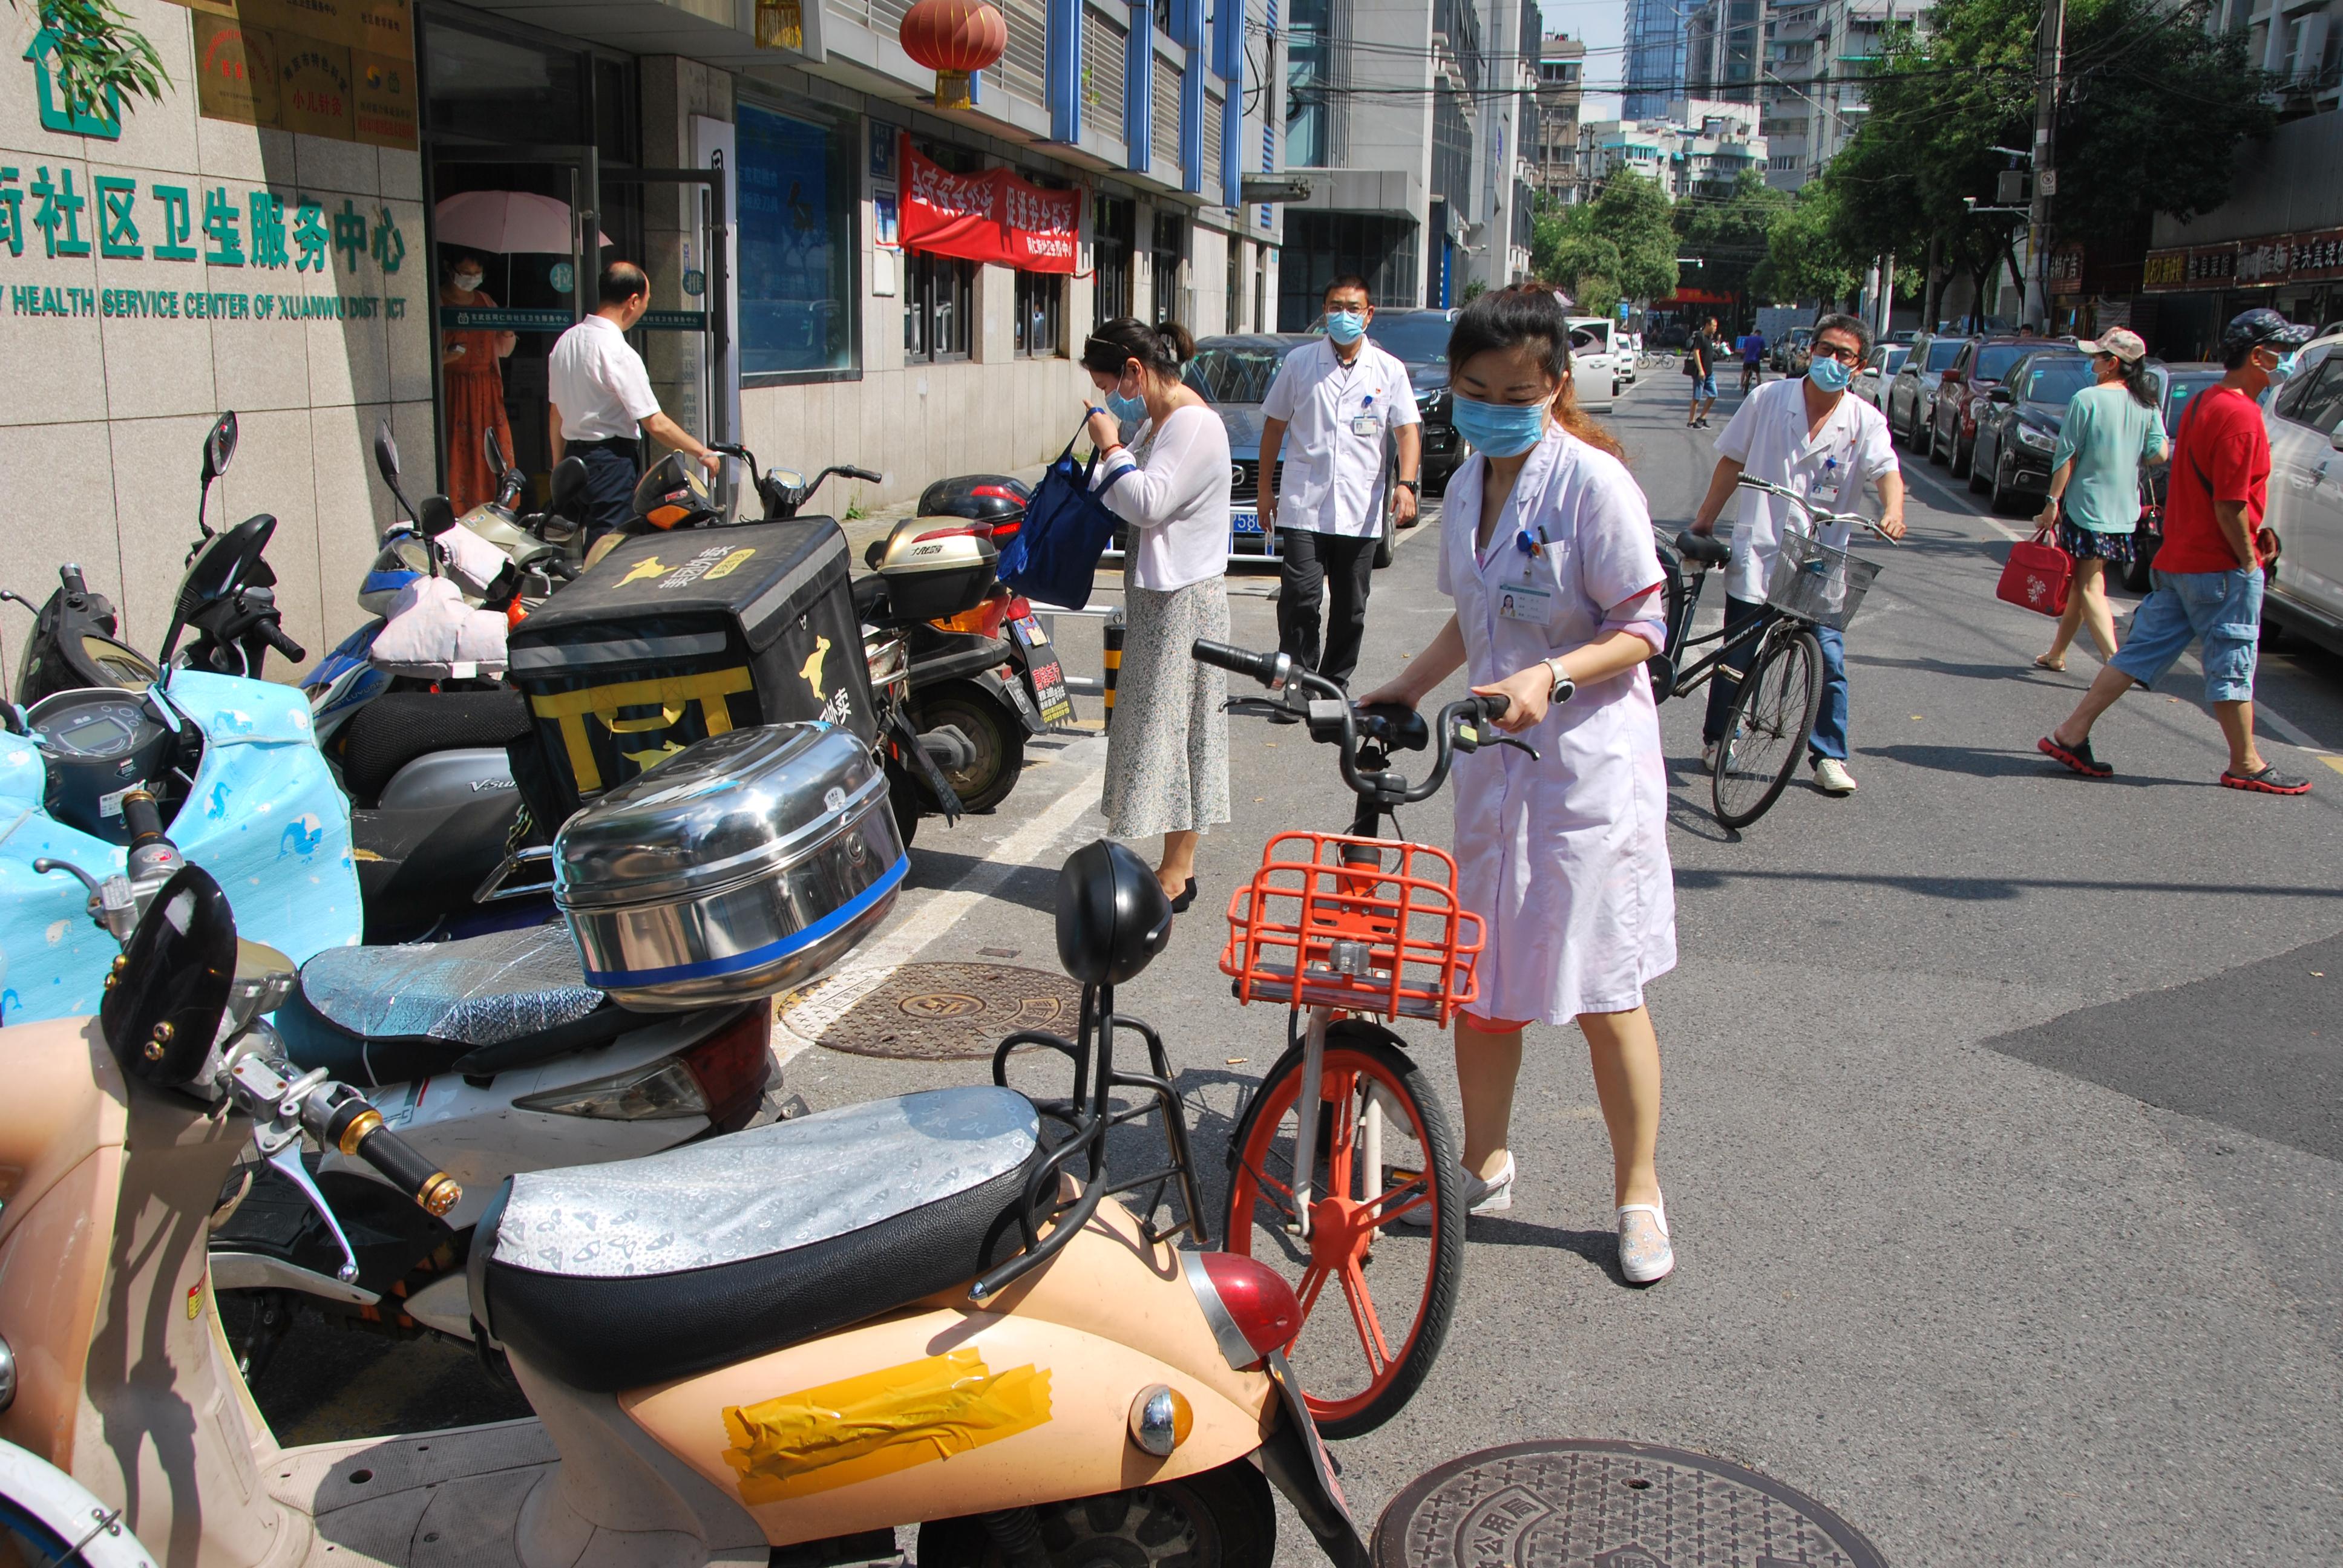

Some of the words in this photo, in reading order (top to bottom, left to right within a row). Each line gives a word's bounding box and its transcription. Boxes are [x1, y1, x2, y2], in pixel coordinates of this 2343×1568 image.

[293, 88, 342, 118] 小儿针灸
[876, 143, 885, 162] 42
[553, 266, 574, 289] 拉
[686, 272, 704, 293] 推
[12, 286, 95, 317] HEALTH
[102, 288, 179, 318] SERVICE
[185, 292, 249, 319] CENTER
[254, 294, 274, 319] OF
[278, 295, 347, 319] XUANWU
[658, 545, 736, 589] 美团外卖
